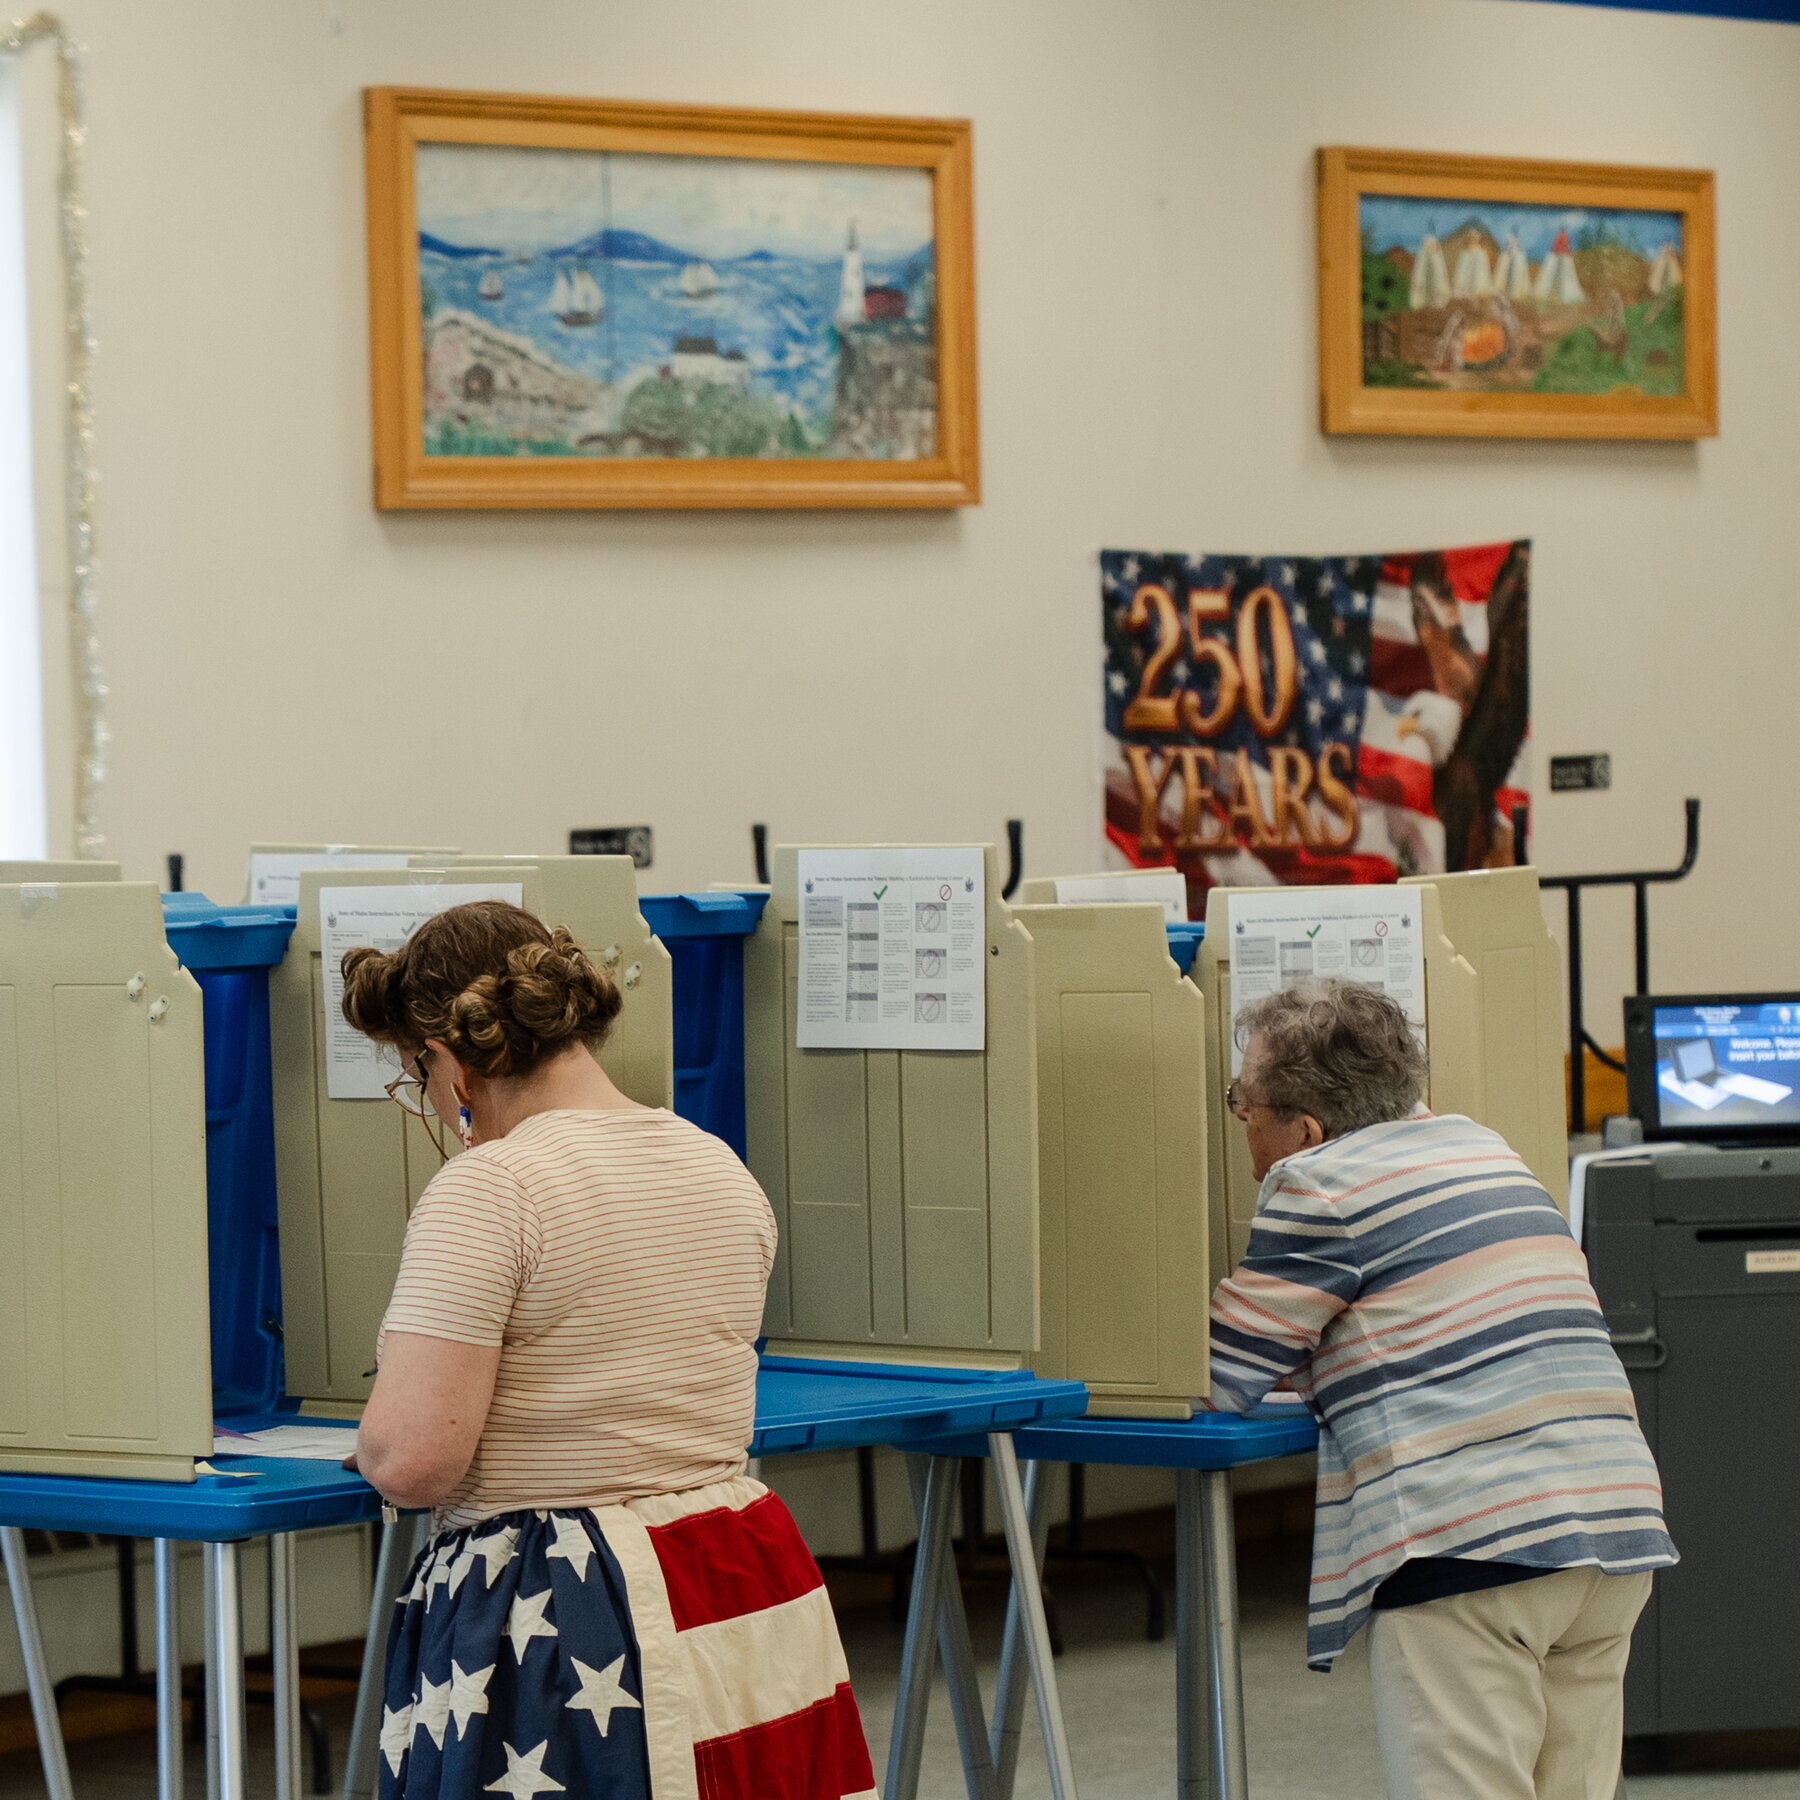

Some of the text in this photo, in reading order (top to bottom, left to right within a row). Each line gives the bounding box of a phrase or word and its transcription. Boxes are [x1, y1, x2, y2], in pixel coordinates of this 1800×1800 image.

[1123, 583, 1297, 738] 250
[1122, 742, 1359, 850] YEARS
[1755, 1051, 1776, 1063] your
